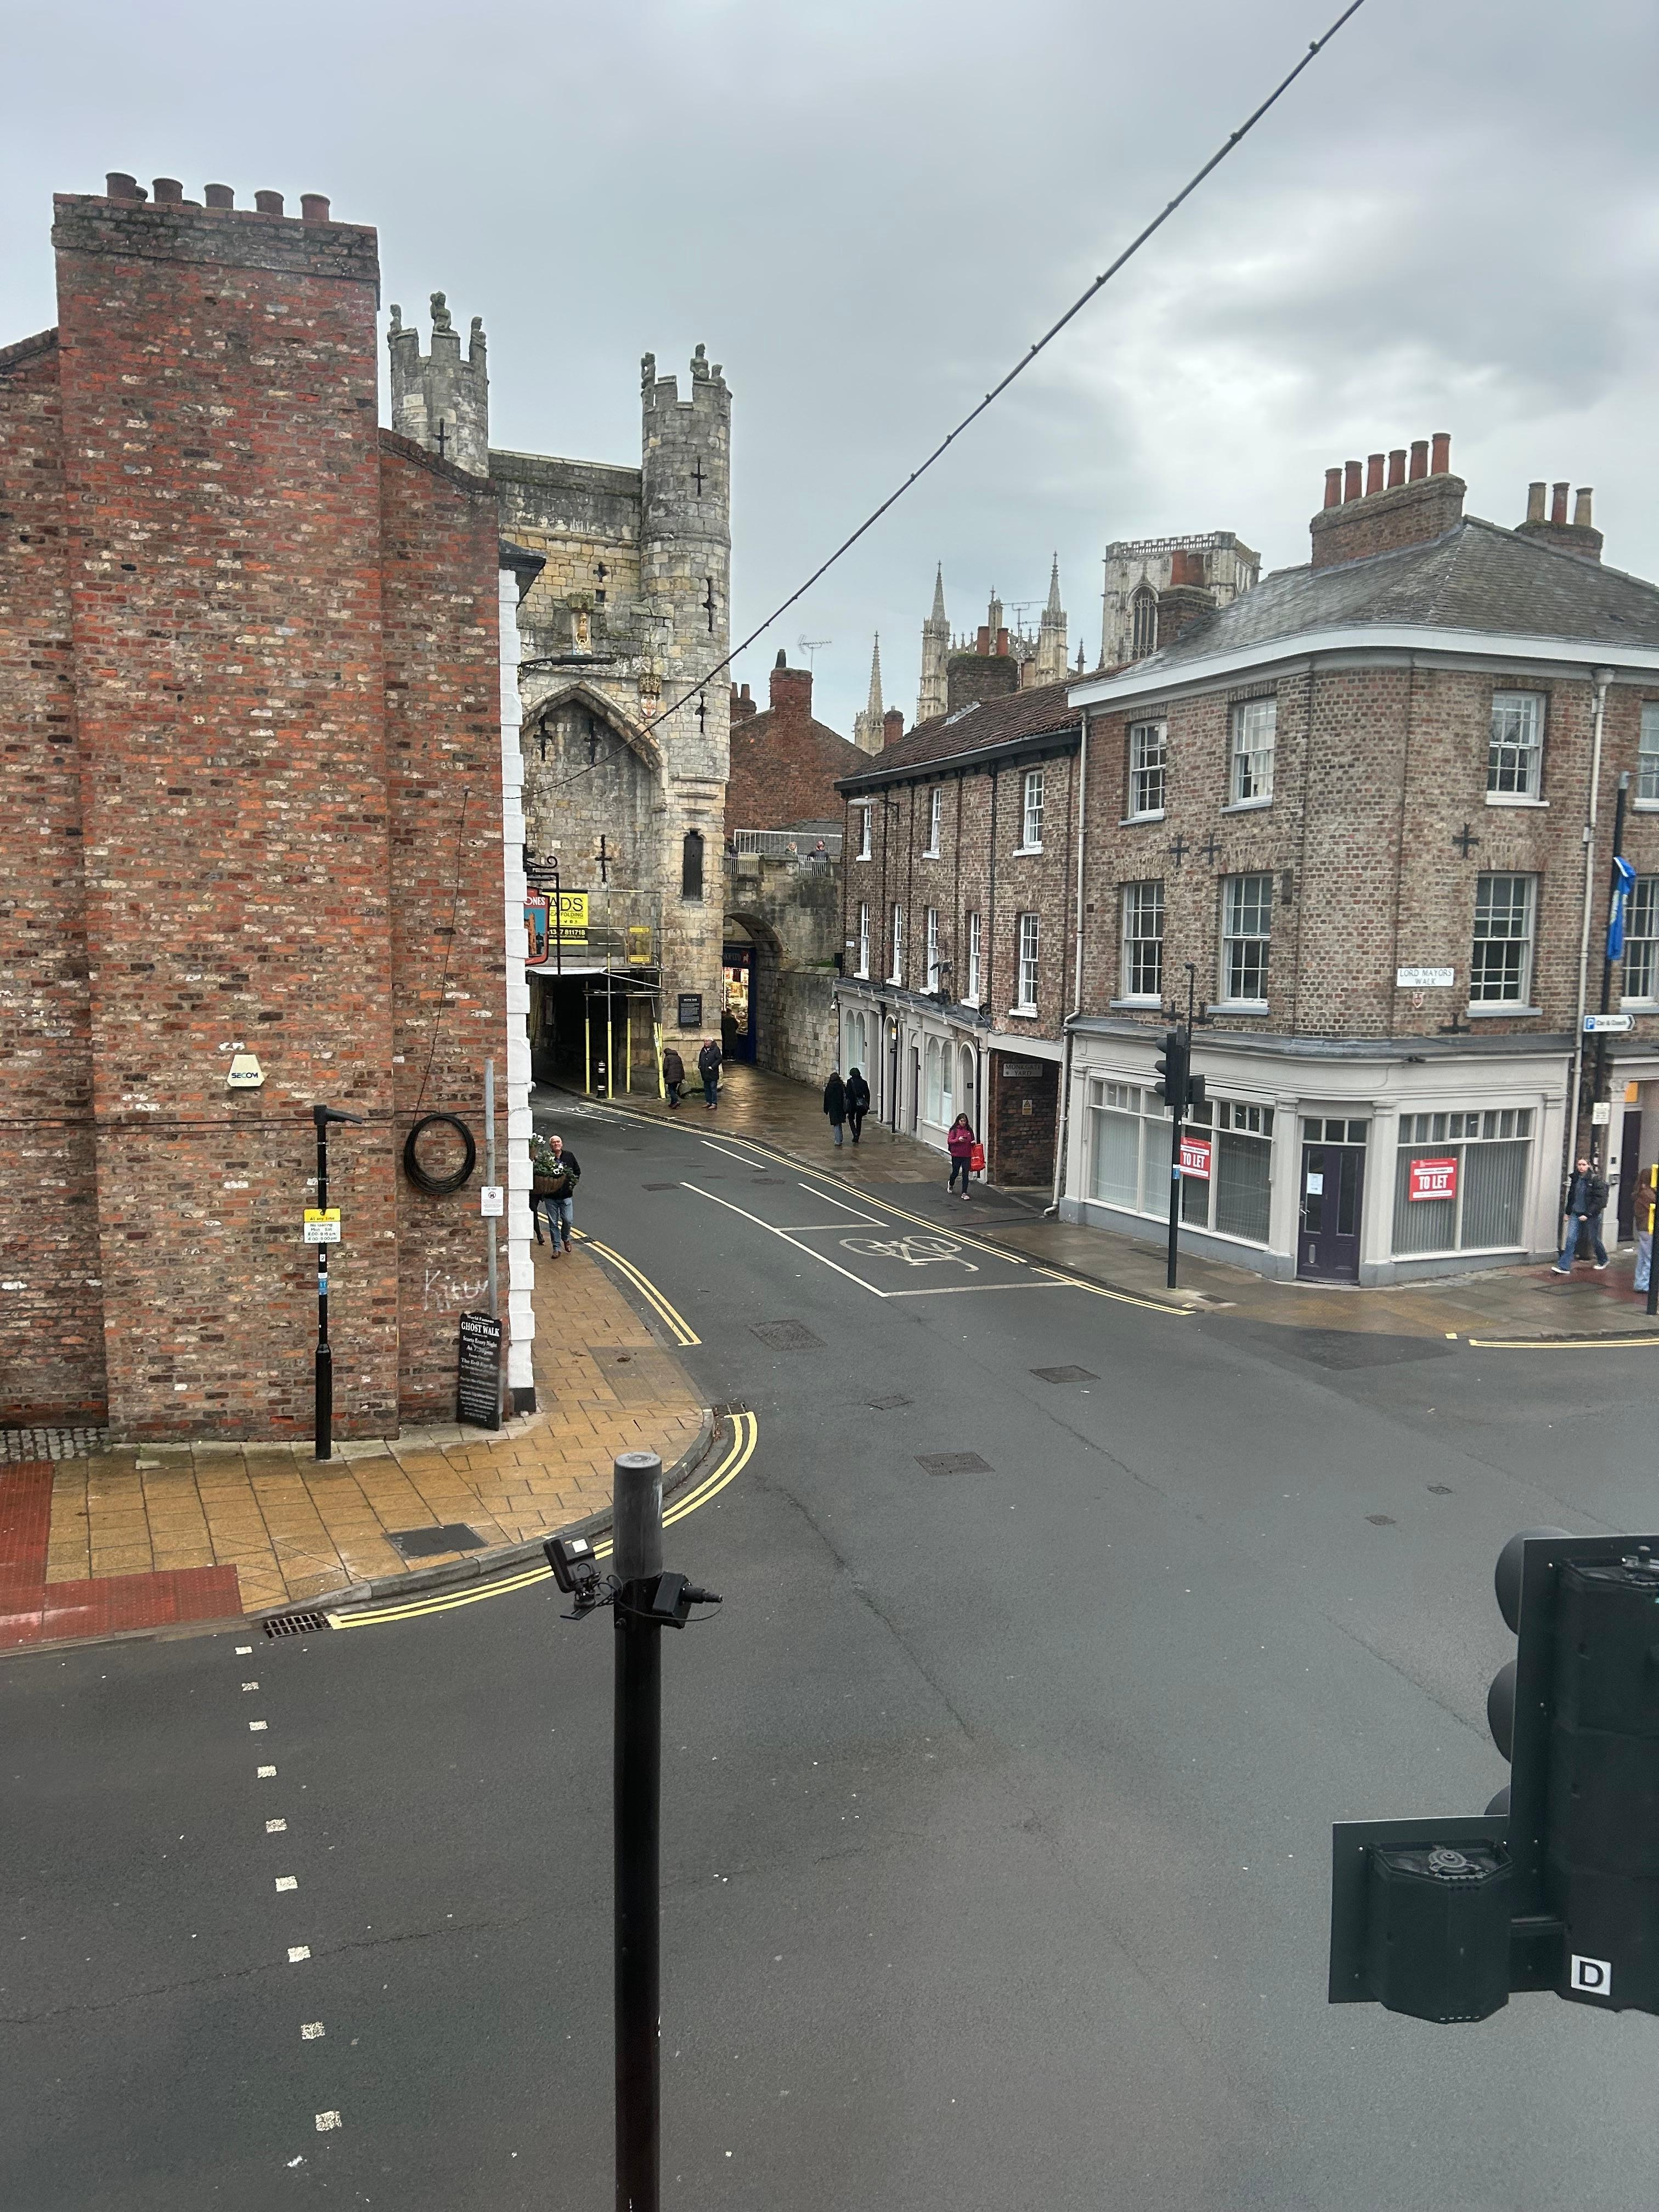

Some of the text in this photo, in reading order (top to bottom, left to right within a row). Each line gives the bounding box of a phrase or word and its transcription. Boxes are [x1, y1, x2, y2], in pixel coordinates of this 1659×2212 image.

[524, 896, 546, 905] ONES
[1182, 1152, 1205, 1169] TO LET
[1419, 1175, 1448, 1190] TO LET
[461, 1321, 483, 1333] GHOST
[483, 1325, 500, 1337] WALK
[1579, 1960, 1604, 1988] D
